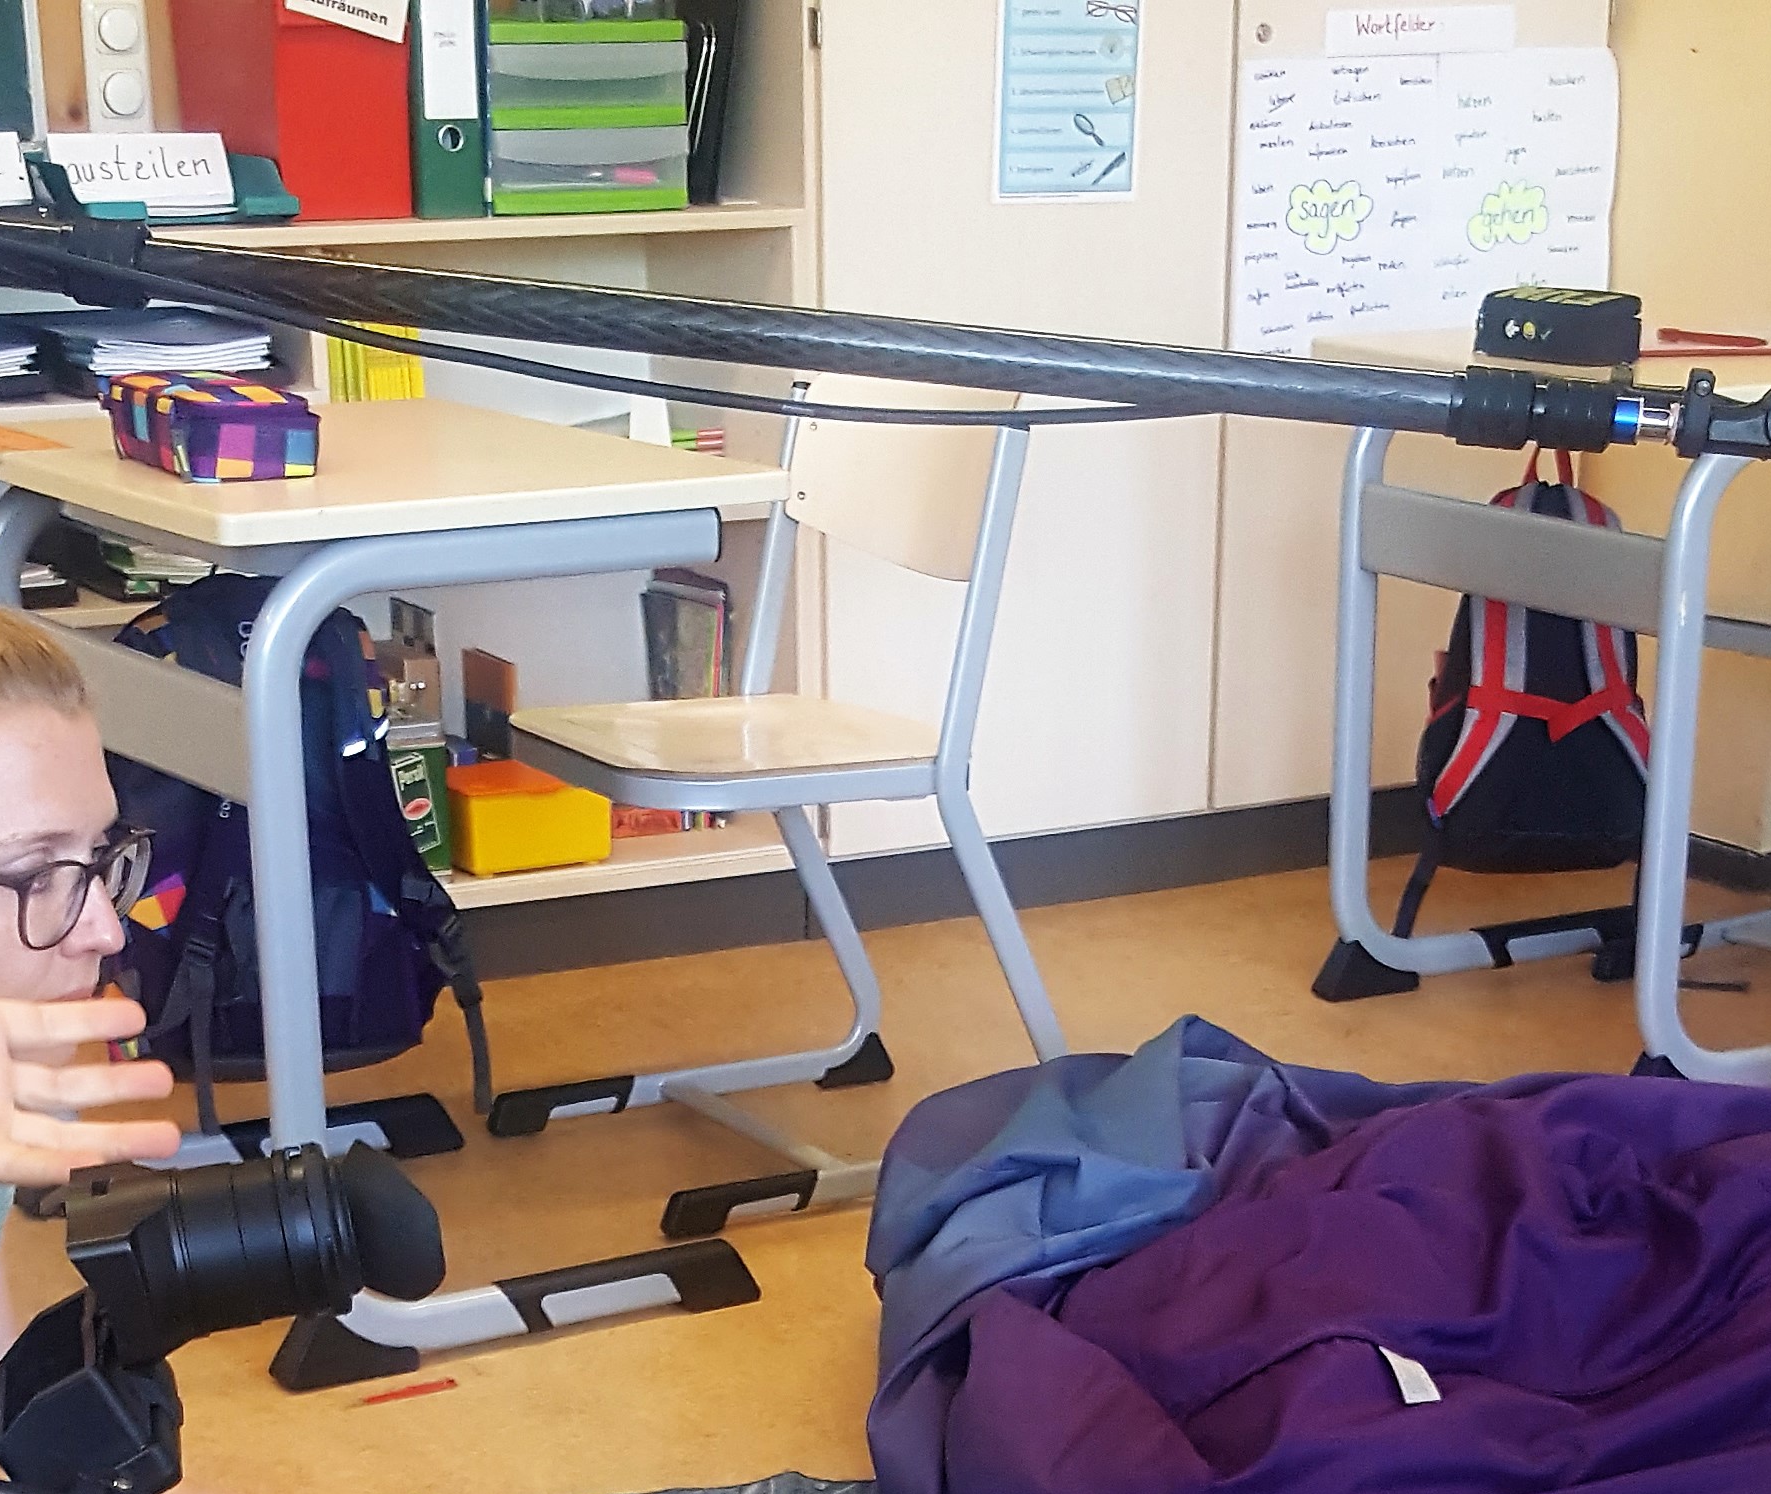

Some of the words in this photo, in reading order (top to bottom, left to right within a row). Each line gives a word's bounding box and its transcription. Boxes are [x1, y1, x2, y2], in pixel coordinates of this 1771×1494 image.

[67, 145, 211, 184] austeilen
[1300, 199, 1356, 239] sagen
[1482, 207, 1534, 244] gehen
